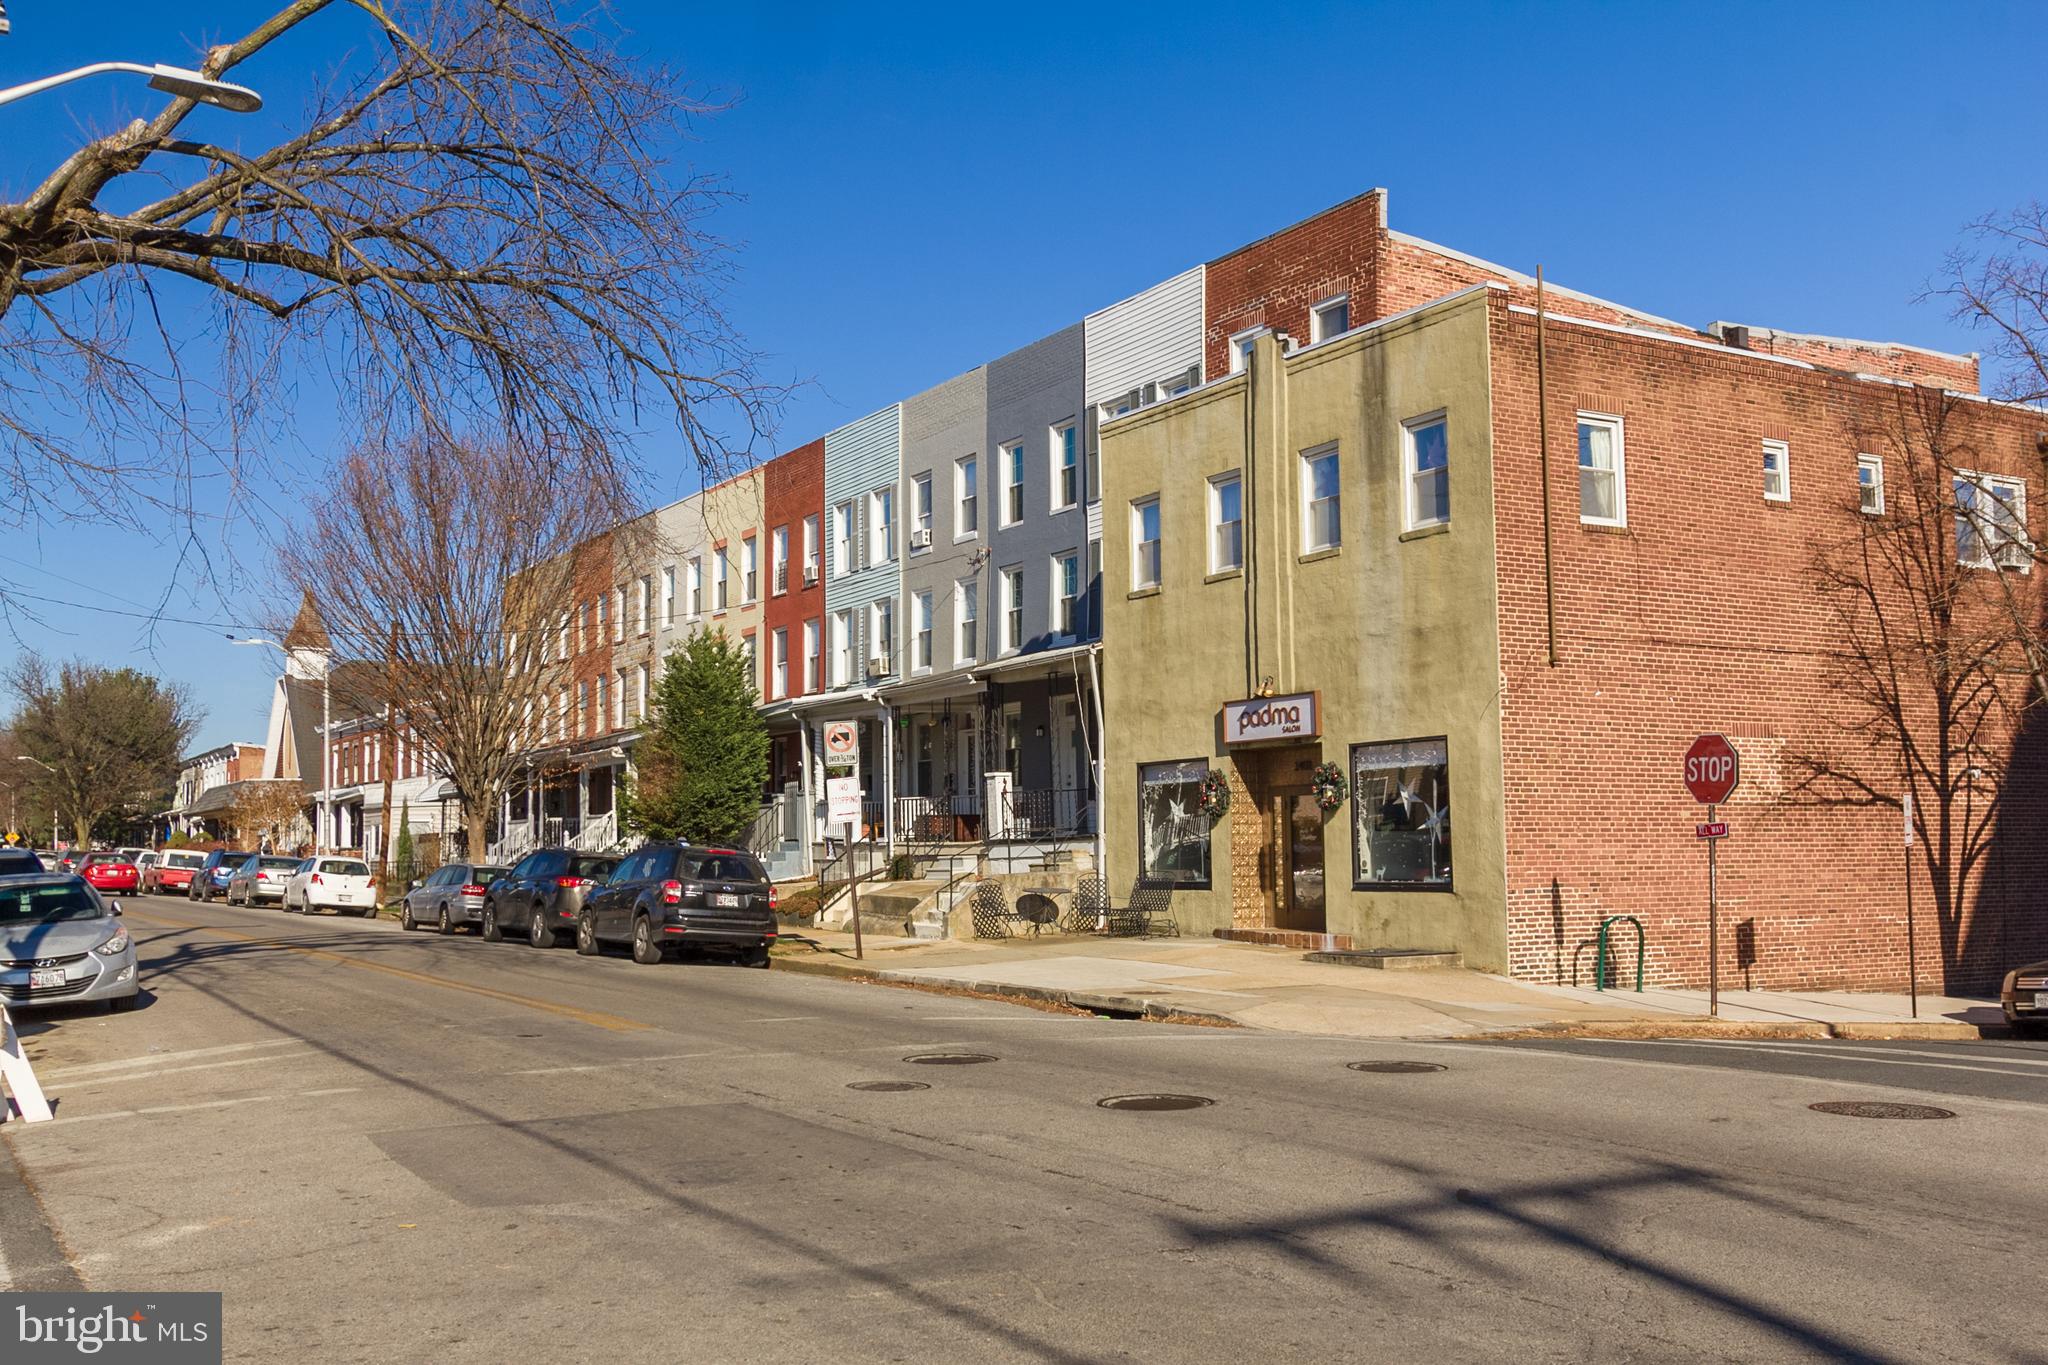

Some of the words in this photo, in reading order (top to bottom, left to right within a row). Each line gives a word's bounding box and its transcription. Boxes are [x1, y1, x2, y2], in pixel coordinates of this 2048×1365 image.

[1240, 703, 1300, 736] padma
[1282, 725, 1301, 733] SALON
[1687, 756, 1732, 782] STOP
[839, 782, 848, 791] NO
[1711, 824, 1724, 834] WAY
